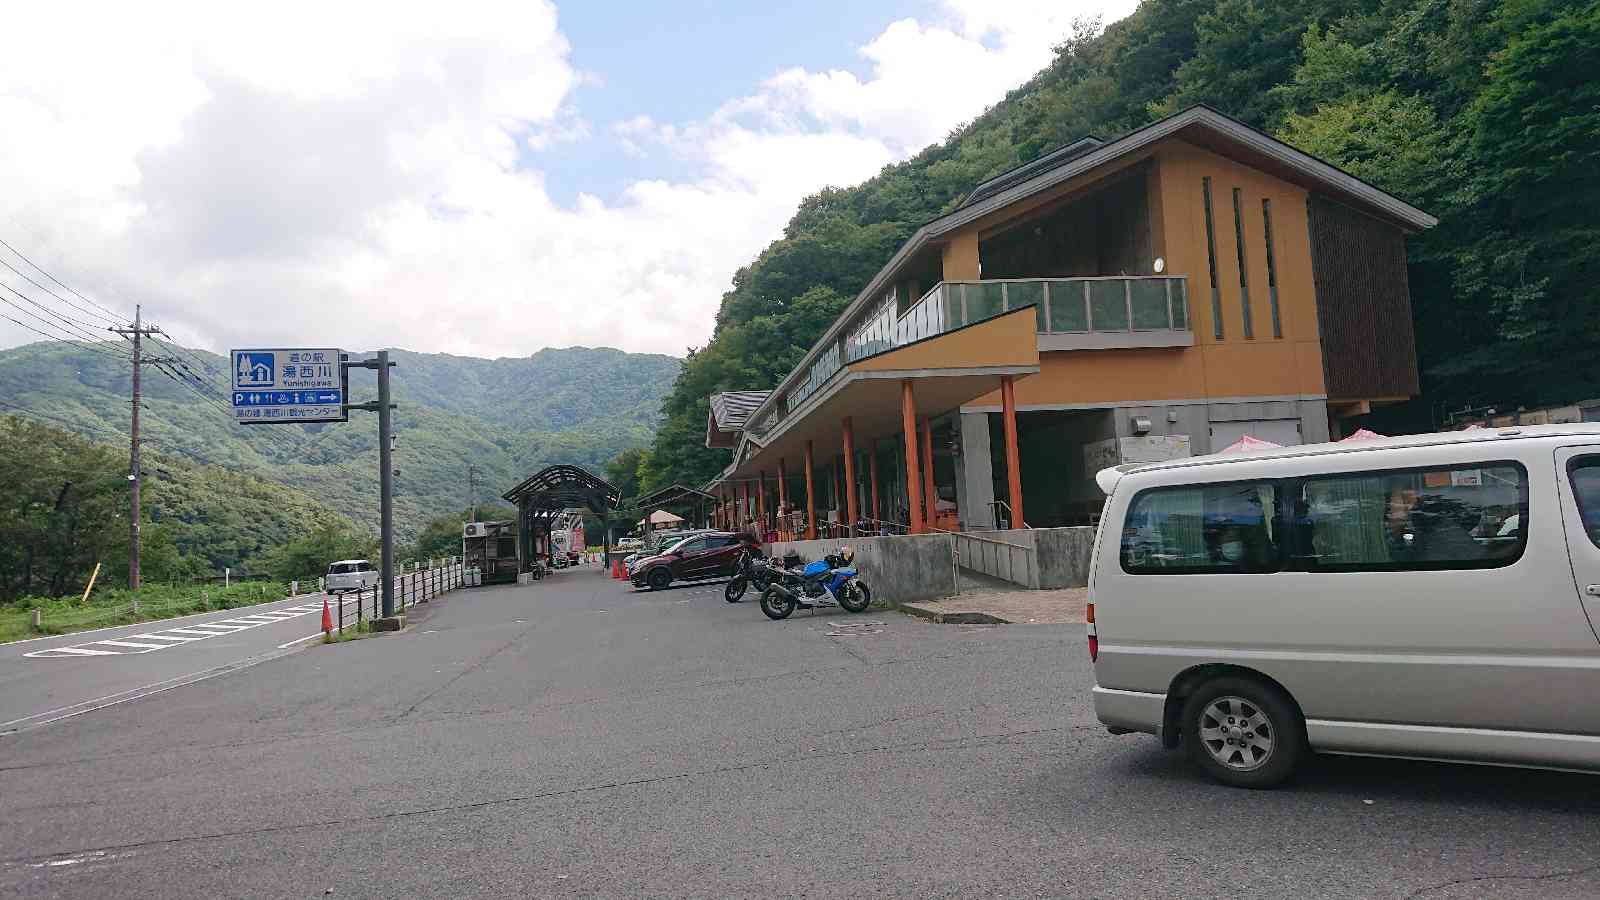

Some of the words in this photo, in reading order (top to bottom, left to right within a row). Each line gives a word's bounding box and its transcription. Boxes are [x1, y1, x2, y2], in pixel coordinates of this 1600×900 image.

[289, 352, 324, 362] 道の駅
[282, 365, 332, 378] 湯西川
[283, 378, 332, 388] Yunishigawa
[235, 393, 244, 404] P
